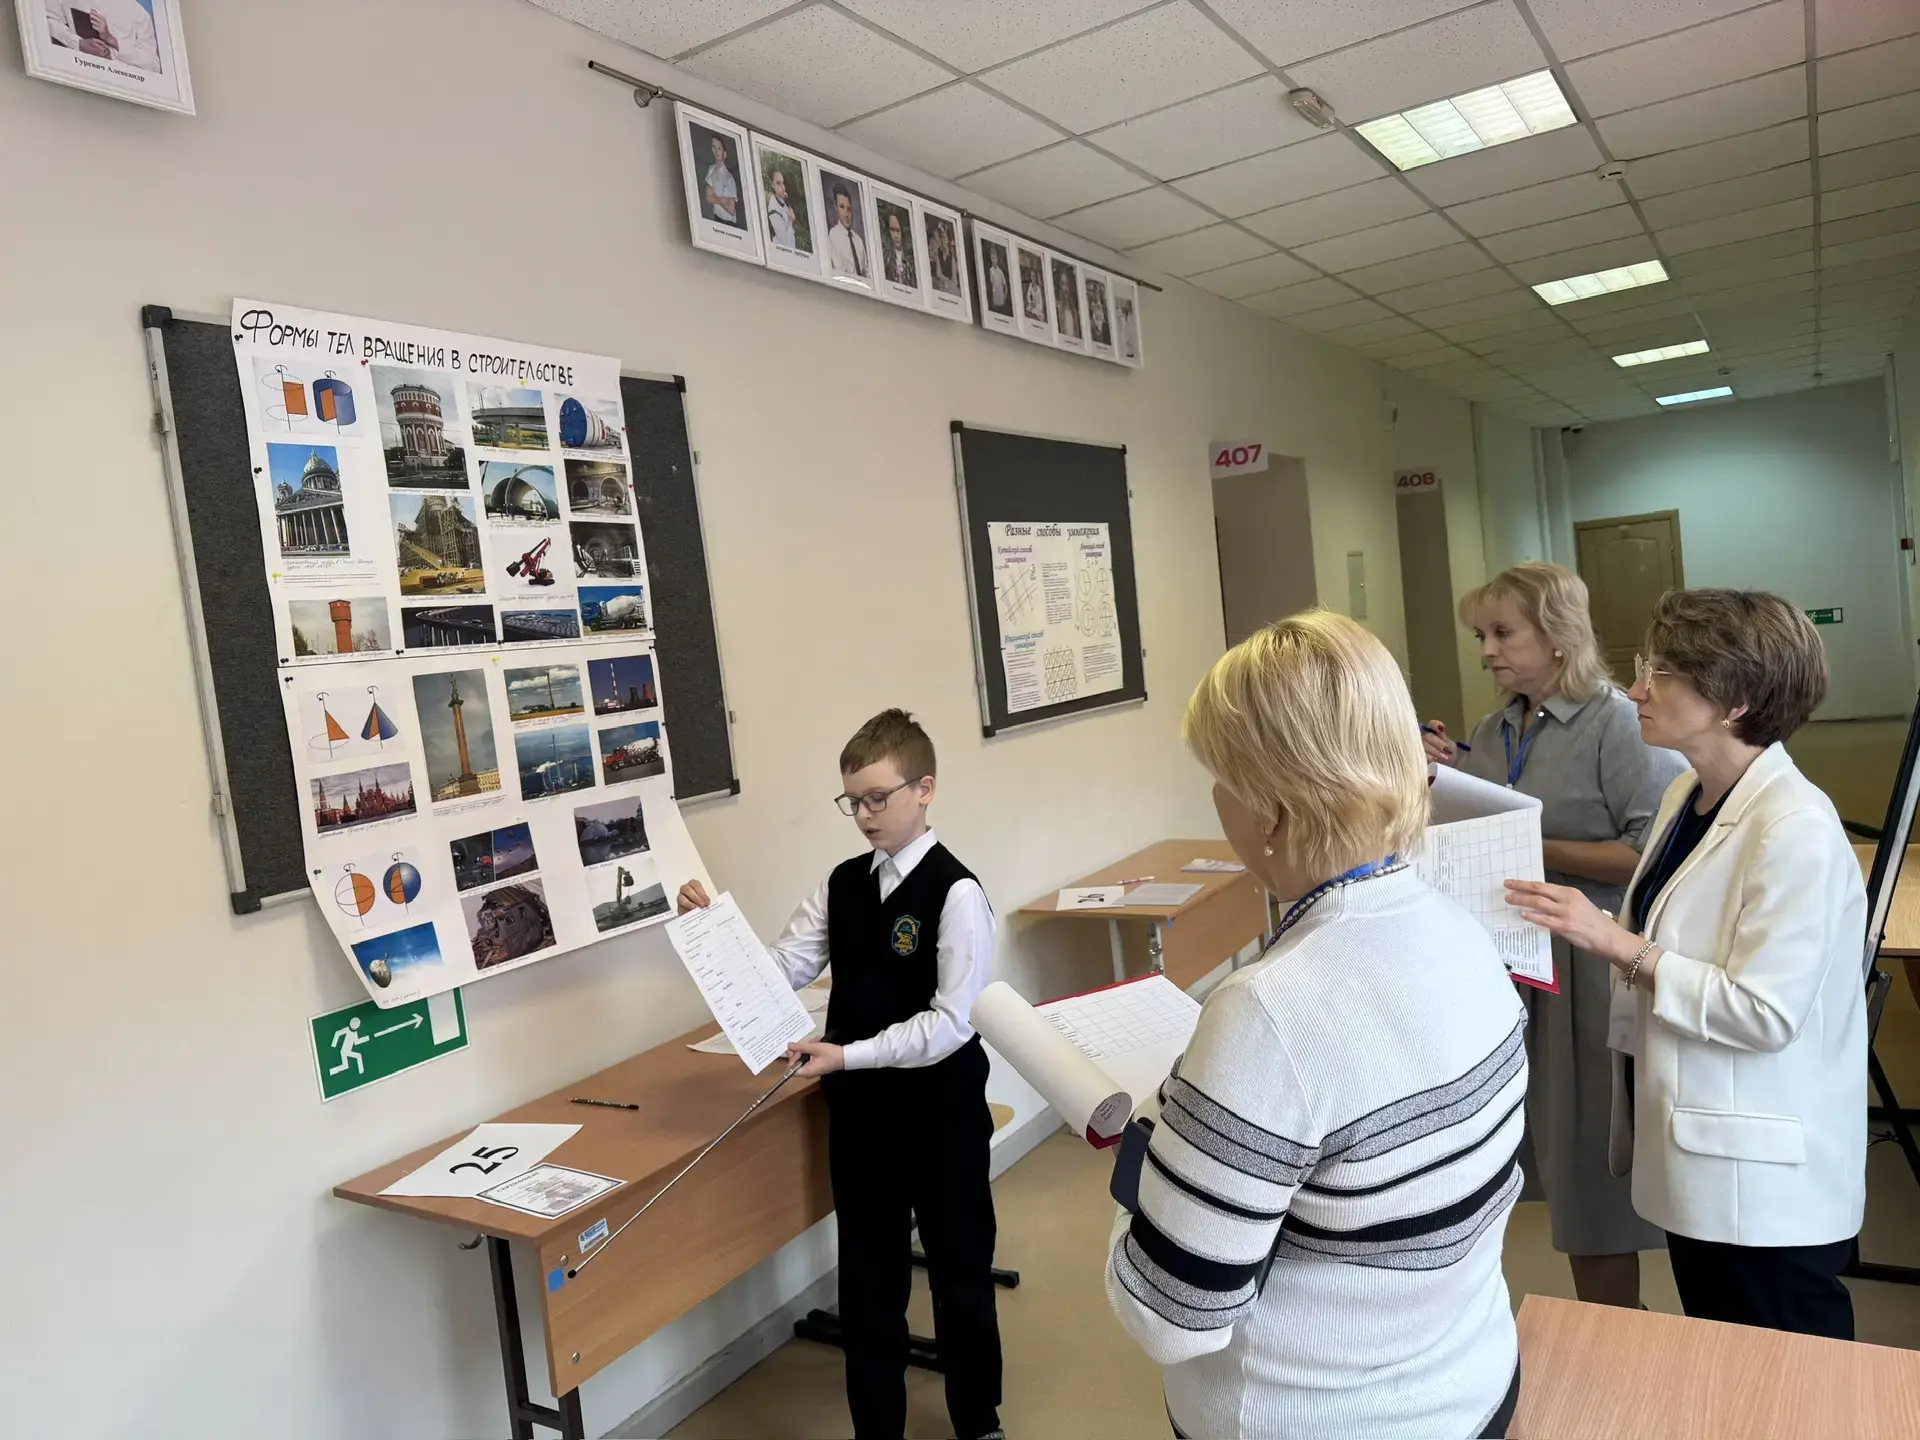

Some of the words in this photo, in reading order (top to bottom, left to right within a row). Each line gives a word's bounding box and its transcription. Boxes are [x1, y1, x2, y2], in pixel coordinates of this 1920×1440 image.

[74, 56, 106, 72] Гуревич
[107, 66, 145, 82] Александр
[327, 331, 355, 356] ТЕЛ
[363, 335, 445, 369] ВРАЩЕНИЯ
[451, 350, 462, 370] В
[468, 353, 575, 386] СТРОИТЕЛЬСТВЕ
[1215, 443, 1262, 468] 407
[1396, 472, 1435, 488] 408
[1005, 524, 1032, 537] Разные
[1036, 523, 1062, 538] способы
[448, 1146, 519, 1176] 25
